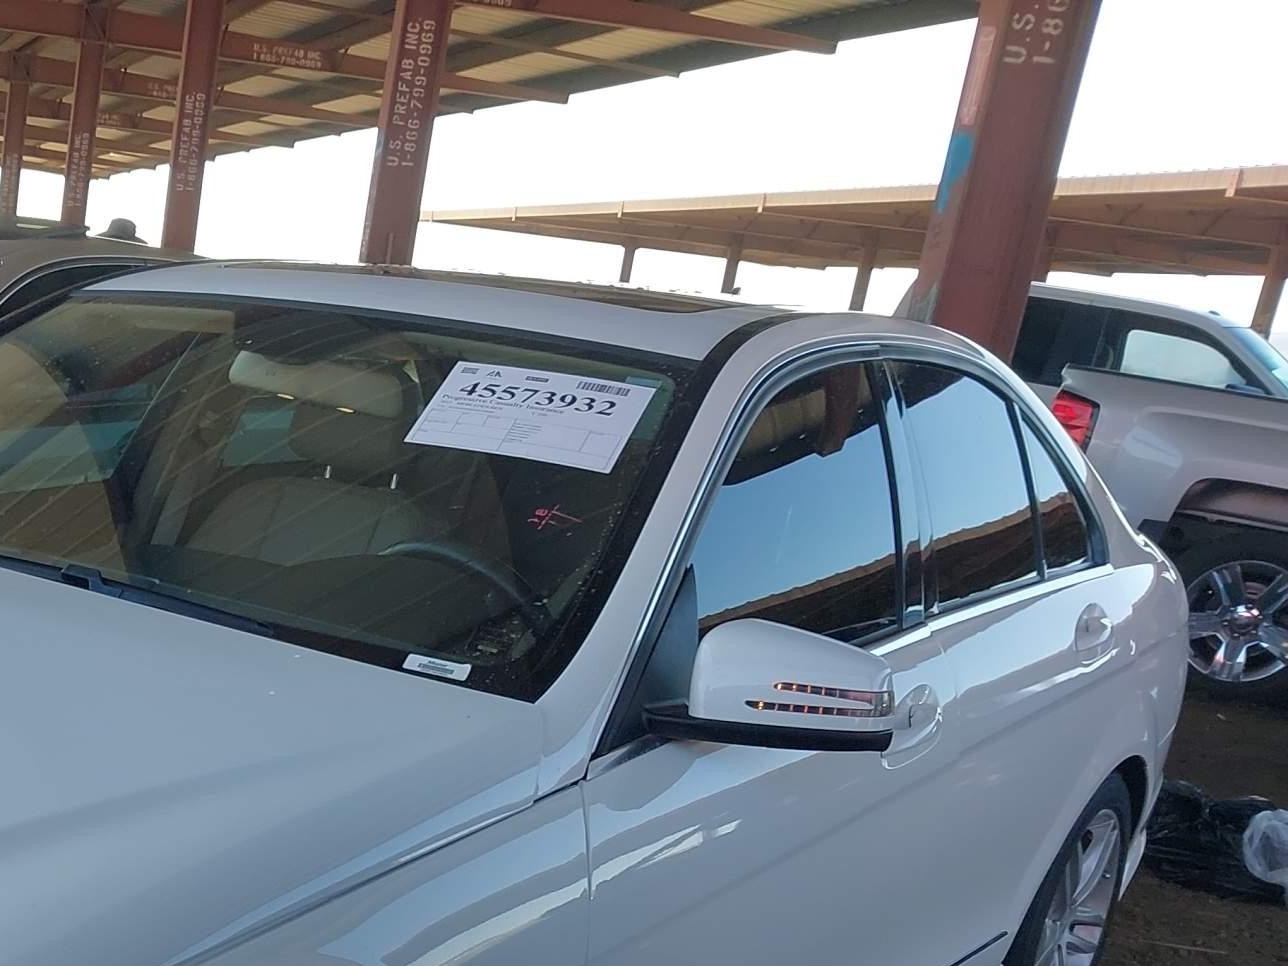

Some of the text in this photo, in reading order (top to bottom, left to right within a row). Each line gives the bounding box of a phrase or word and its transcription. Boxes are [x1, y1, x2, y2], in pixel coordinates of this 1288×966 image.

[1003, 4, 1039, 64] U.S.
[386, 18, 422, 167] U.S. PREFAB INC.
[402, 20, 436, 167] 1-866-799-0969
[178, 119, 192, 164] PREFAB
[442, 394, 487, 405] Progressive
[526, 404, 565, 414] Insurance
[459, 381, 617, 417] 45573932
